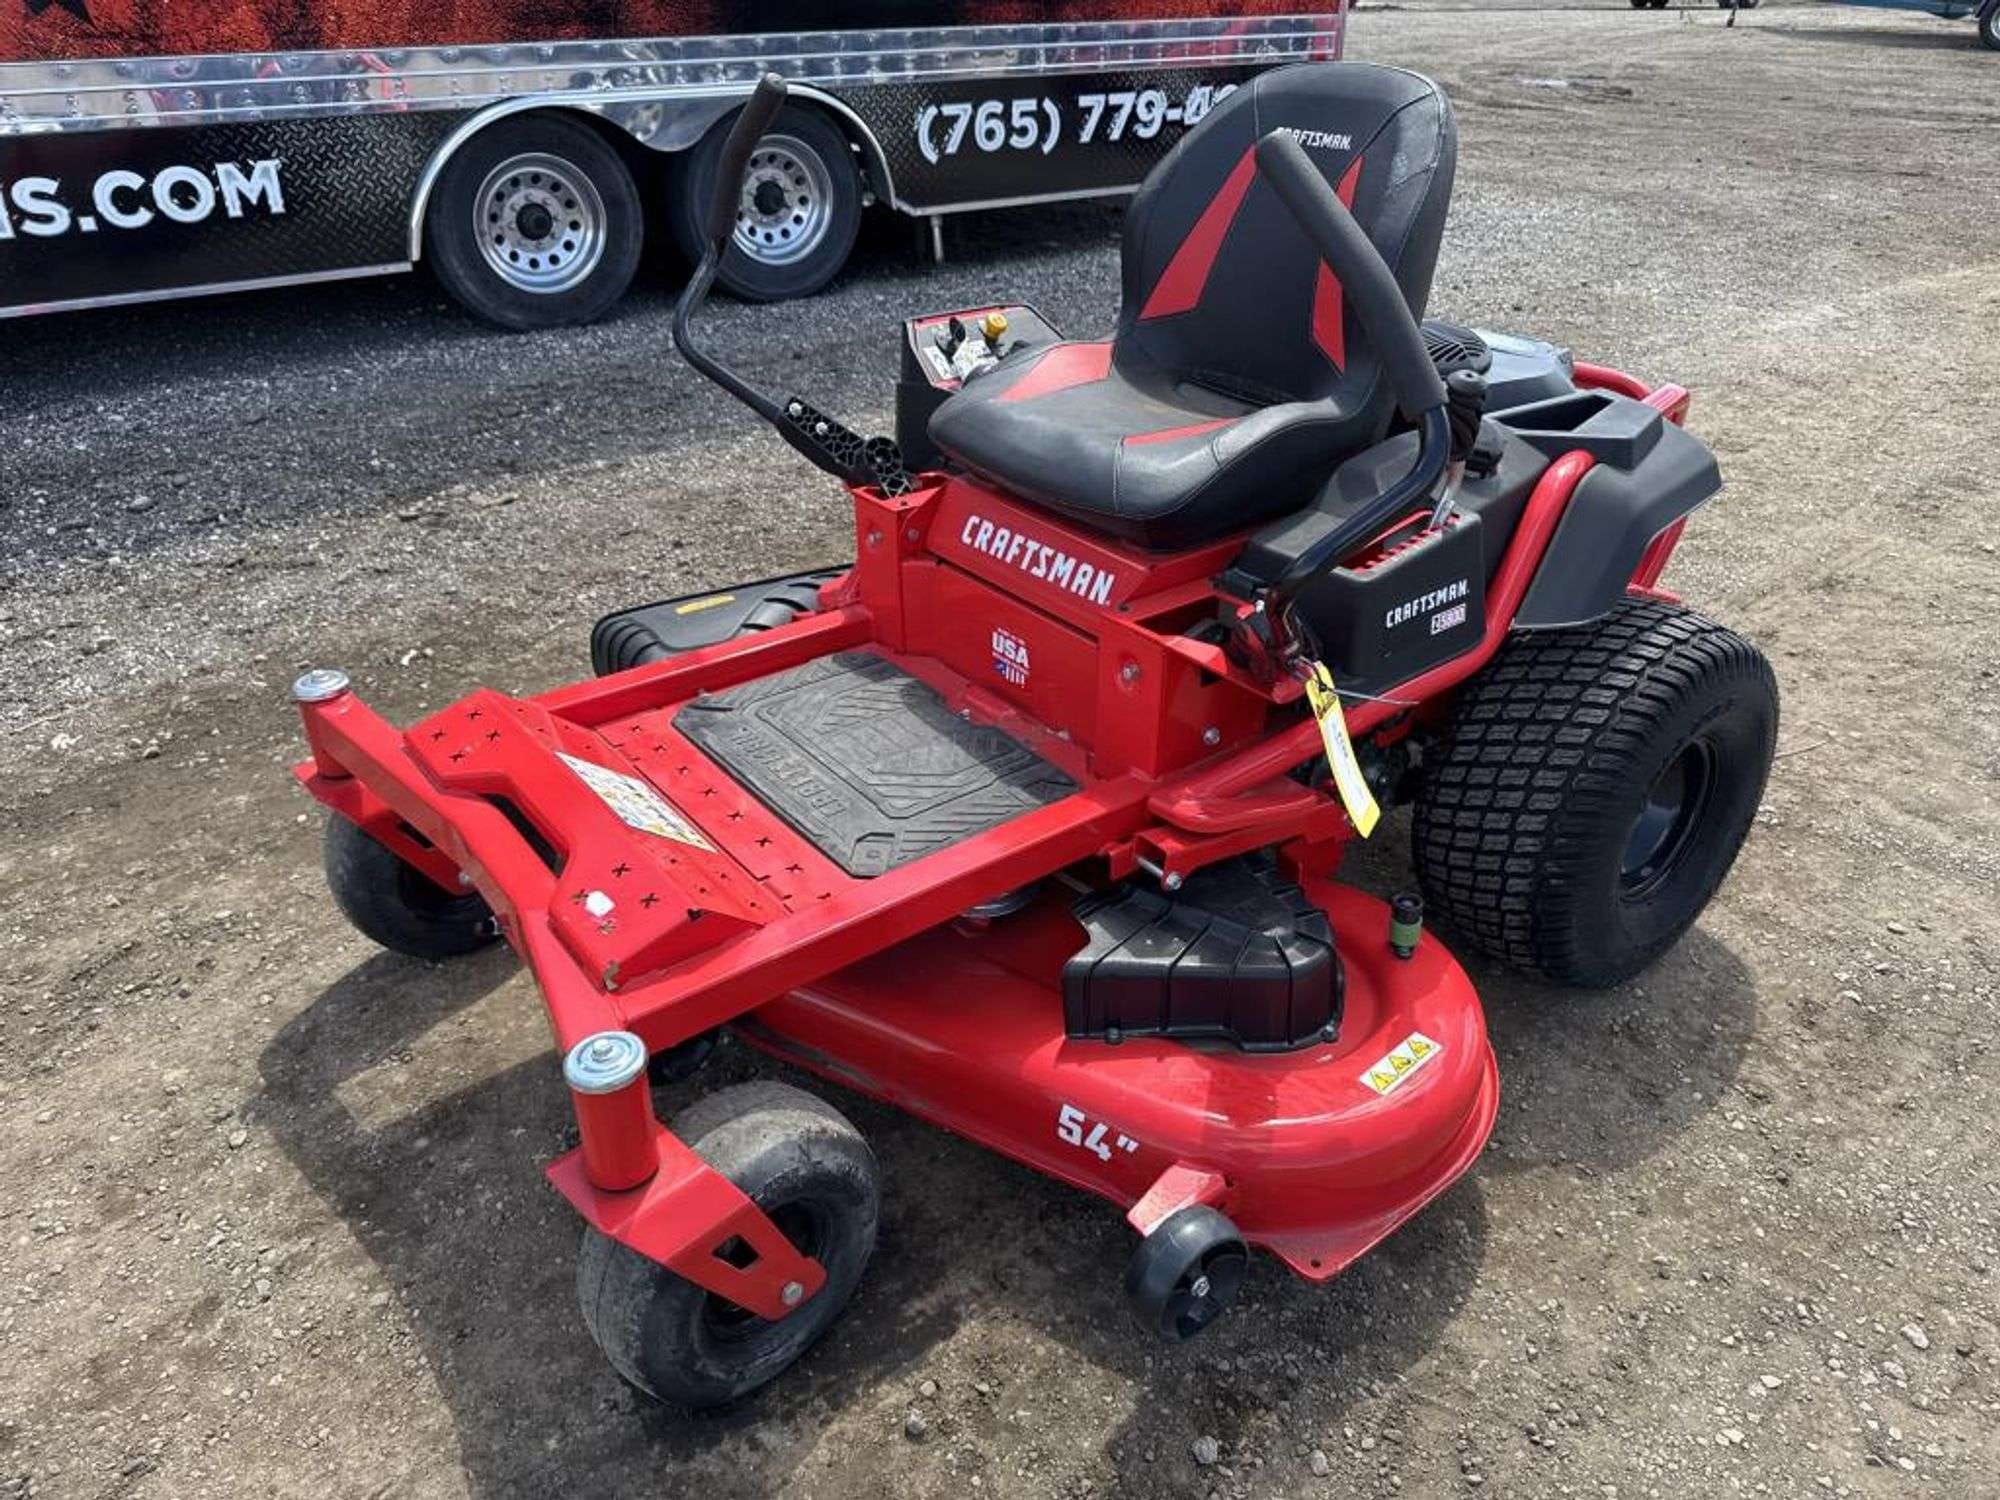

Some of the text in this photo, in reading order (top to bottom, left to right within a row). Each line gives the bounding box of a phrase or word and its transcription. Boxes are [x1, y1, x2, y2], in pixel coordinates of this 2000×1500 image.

[917, 97, 1061, 165] (765)
[0, 160, 286, 239] S.COM
[961, 515, 1115, 605] CRAFTSMAN
[1386, 579, 1468, 628] CRAFTSMAN
[992, 631, 1029, 669] USA
[1058, 1103, 1140, 1161] 54"
